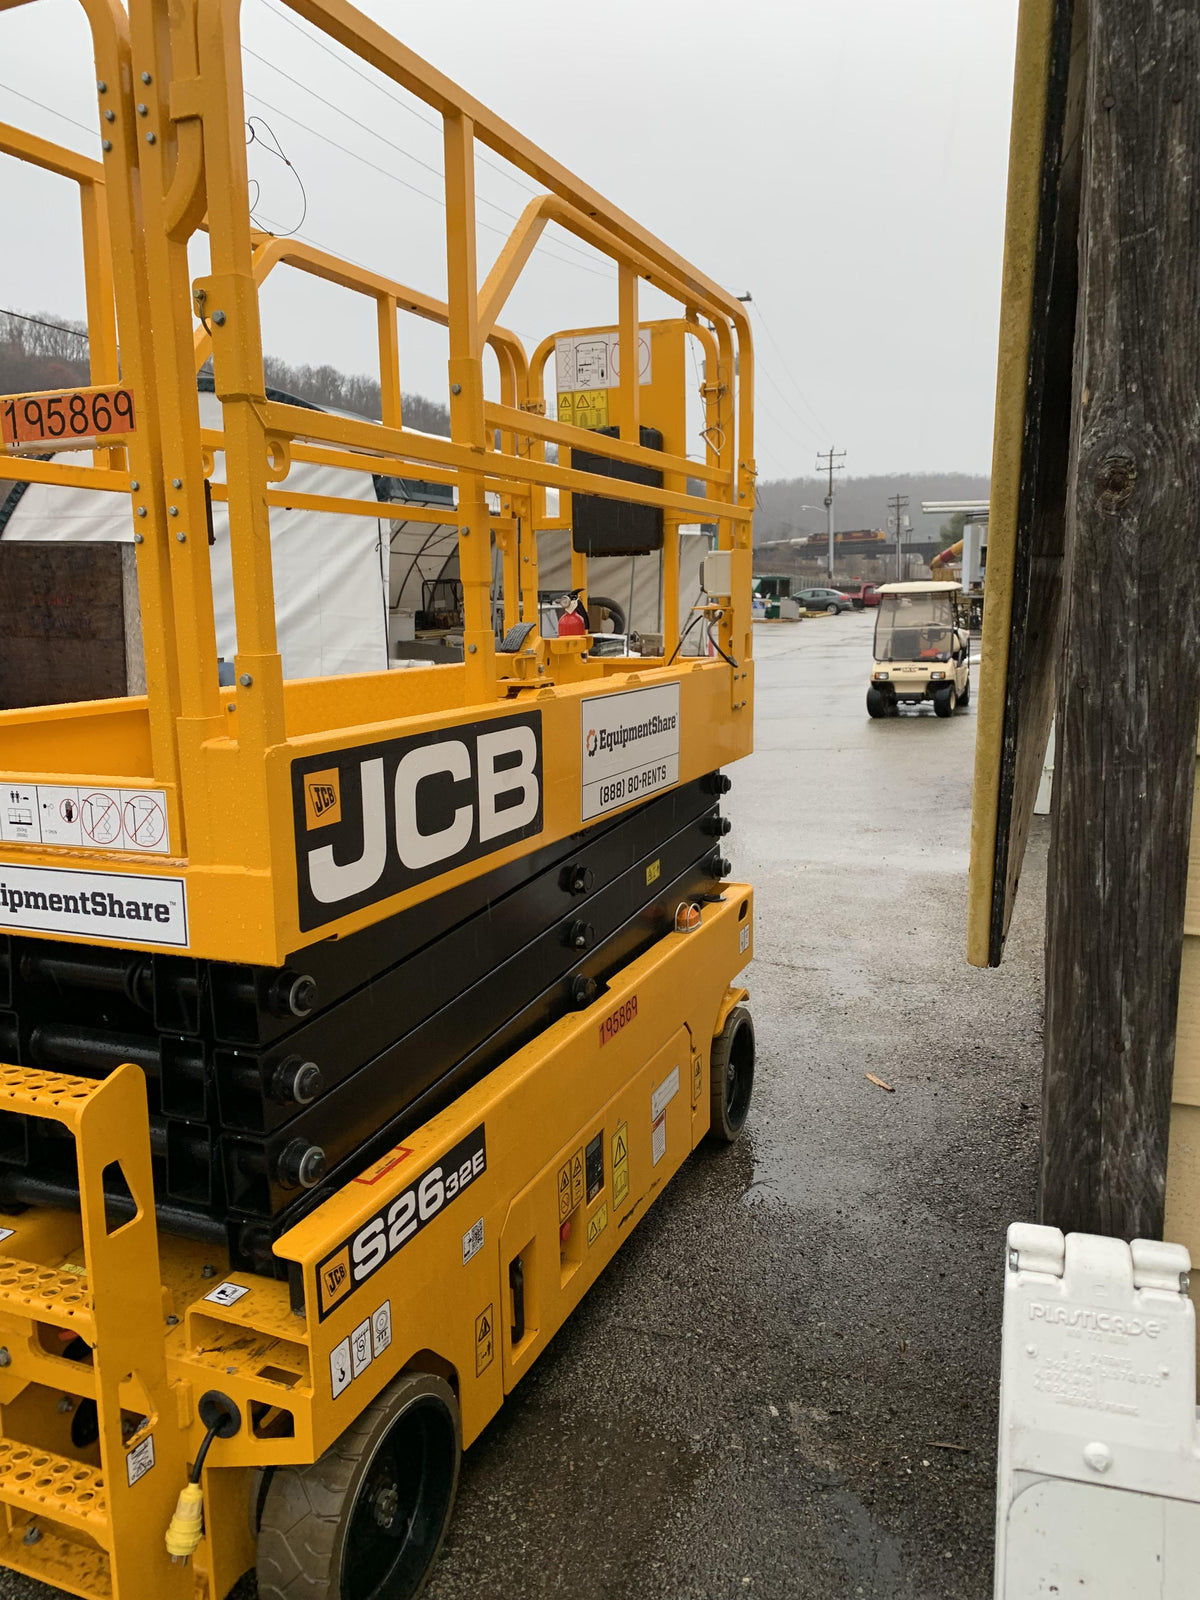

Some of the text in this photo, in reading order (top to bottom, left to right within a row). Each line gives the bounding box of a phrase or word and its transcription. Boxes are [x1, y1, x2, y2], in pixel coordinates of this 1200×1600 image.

[5, 390, 134, 439] 195869
[599, 715, 676, 752] EquipmentShare
[313, 786, 335, 812] JCB
[600, 764, 667, 806] (888) 80-RENTS
[308, 725, 539, 904] JCB
[0, 883, 170, 923] ipmentShare
[600, 995, 637, 1046] 195869
[327, 1263, 346, 1293] JCB
[1029, 1302, 1160, 1339] PLASTICADE
